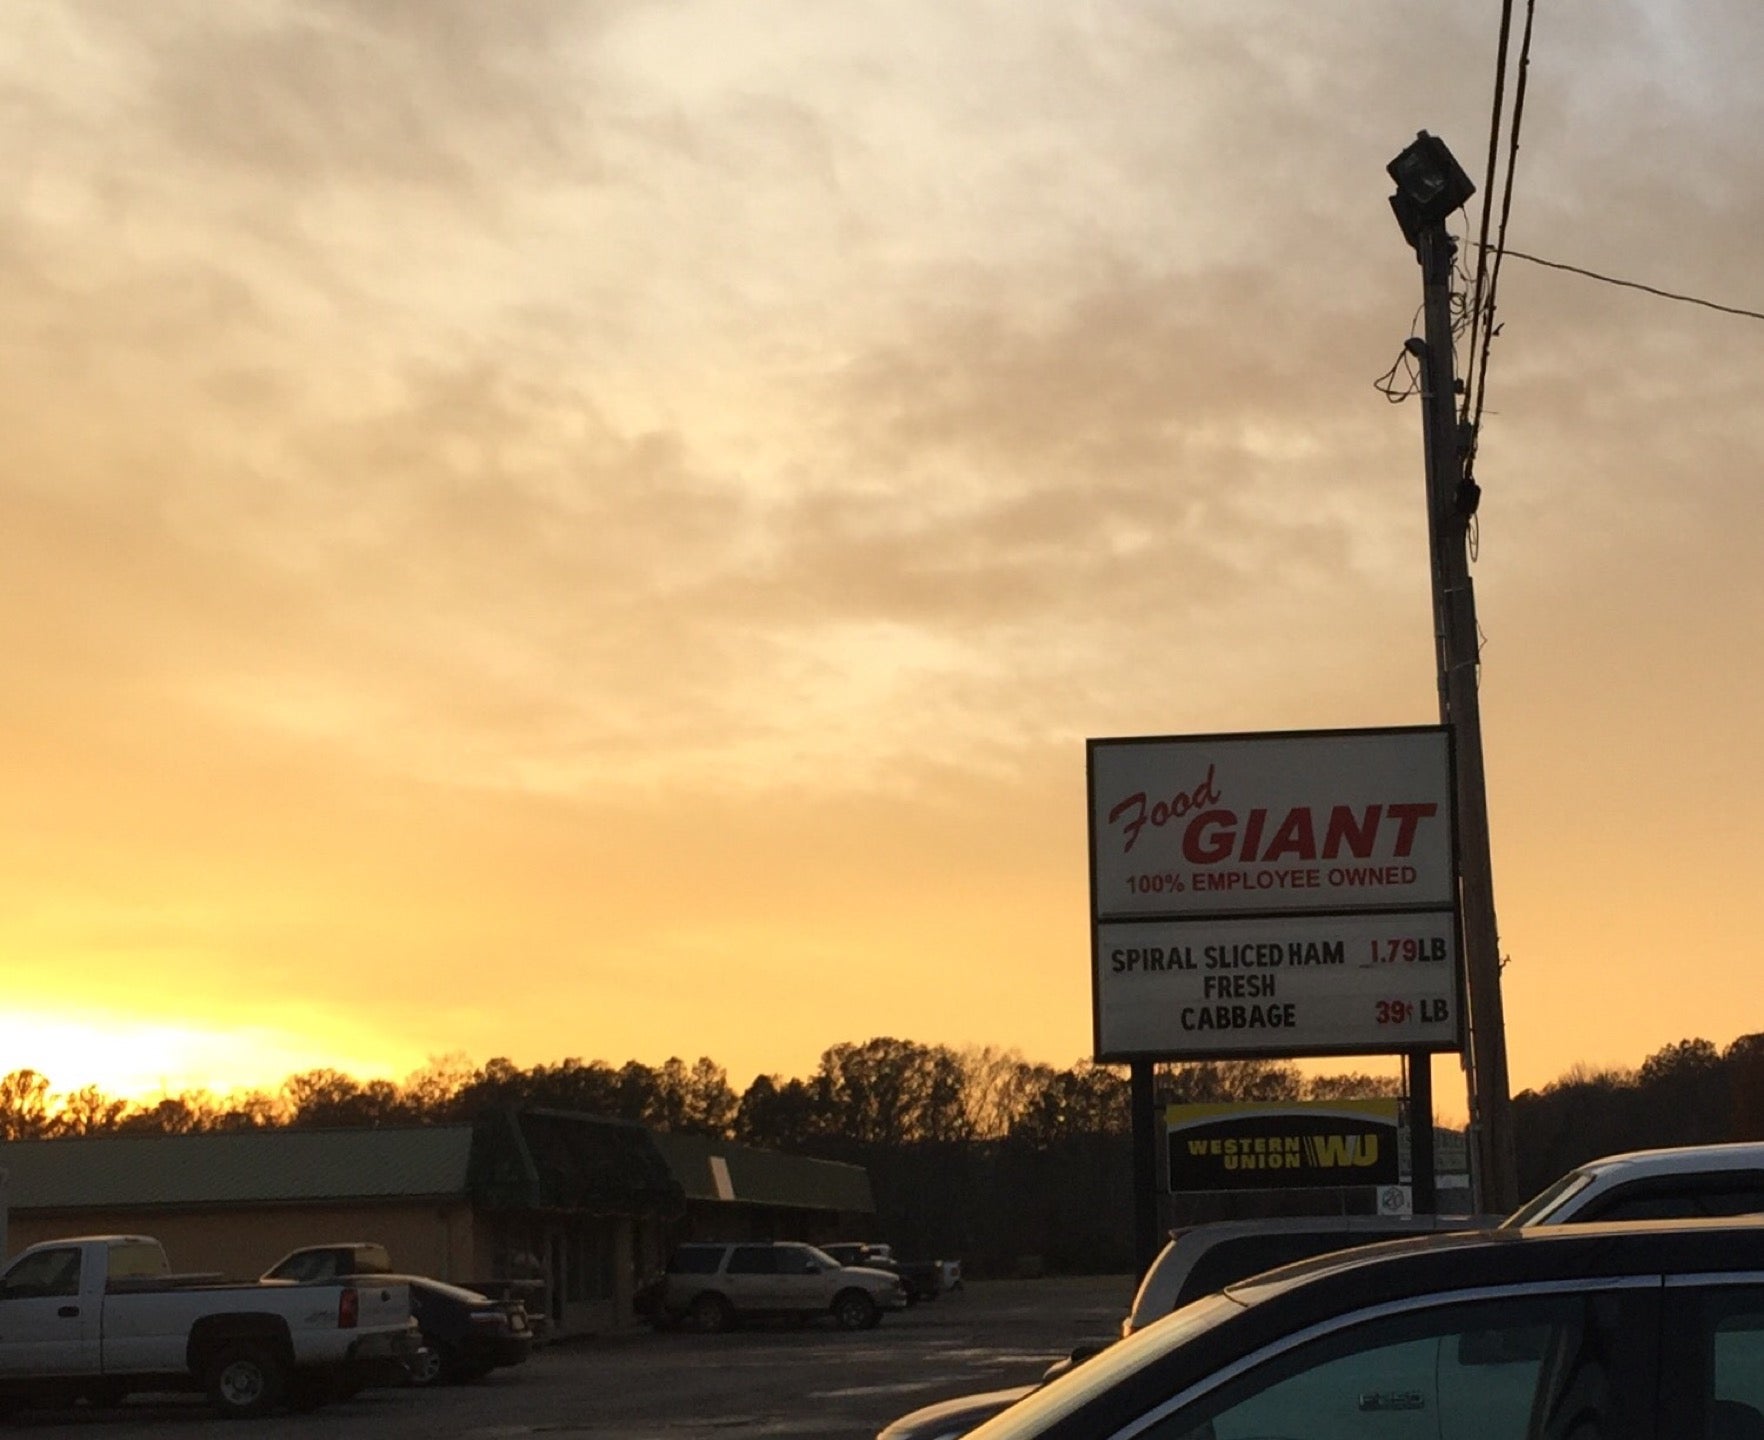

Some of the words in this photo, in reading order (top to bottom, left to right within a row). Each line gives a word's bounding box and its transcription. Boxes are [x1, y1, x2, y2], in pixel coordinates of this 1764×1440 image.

[1108, 763, 1221, 854] Food
[1181, 803, 1438, 865] GIANT
[1126, 873, 1185, 895] 100%
[1192, 868, 1321, 892] EMPLOYEE
[1328, 866, 1418, 887] OWNED
[1111, 947, 1198, 974] SPIRAL
[1204, 943, 1284, 970] SLICED
[1288, 940, 1345, 967] HAM
[1203, 974, 1276, 999] FRESH
[1180, 1003, 1297, 1031] CABBAGE
[1420, 998, 1449, 1023] LB
[1187, 1136, 1300, 1156] WESTERN
[1223, 1152, 1302, 1170] UNION
